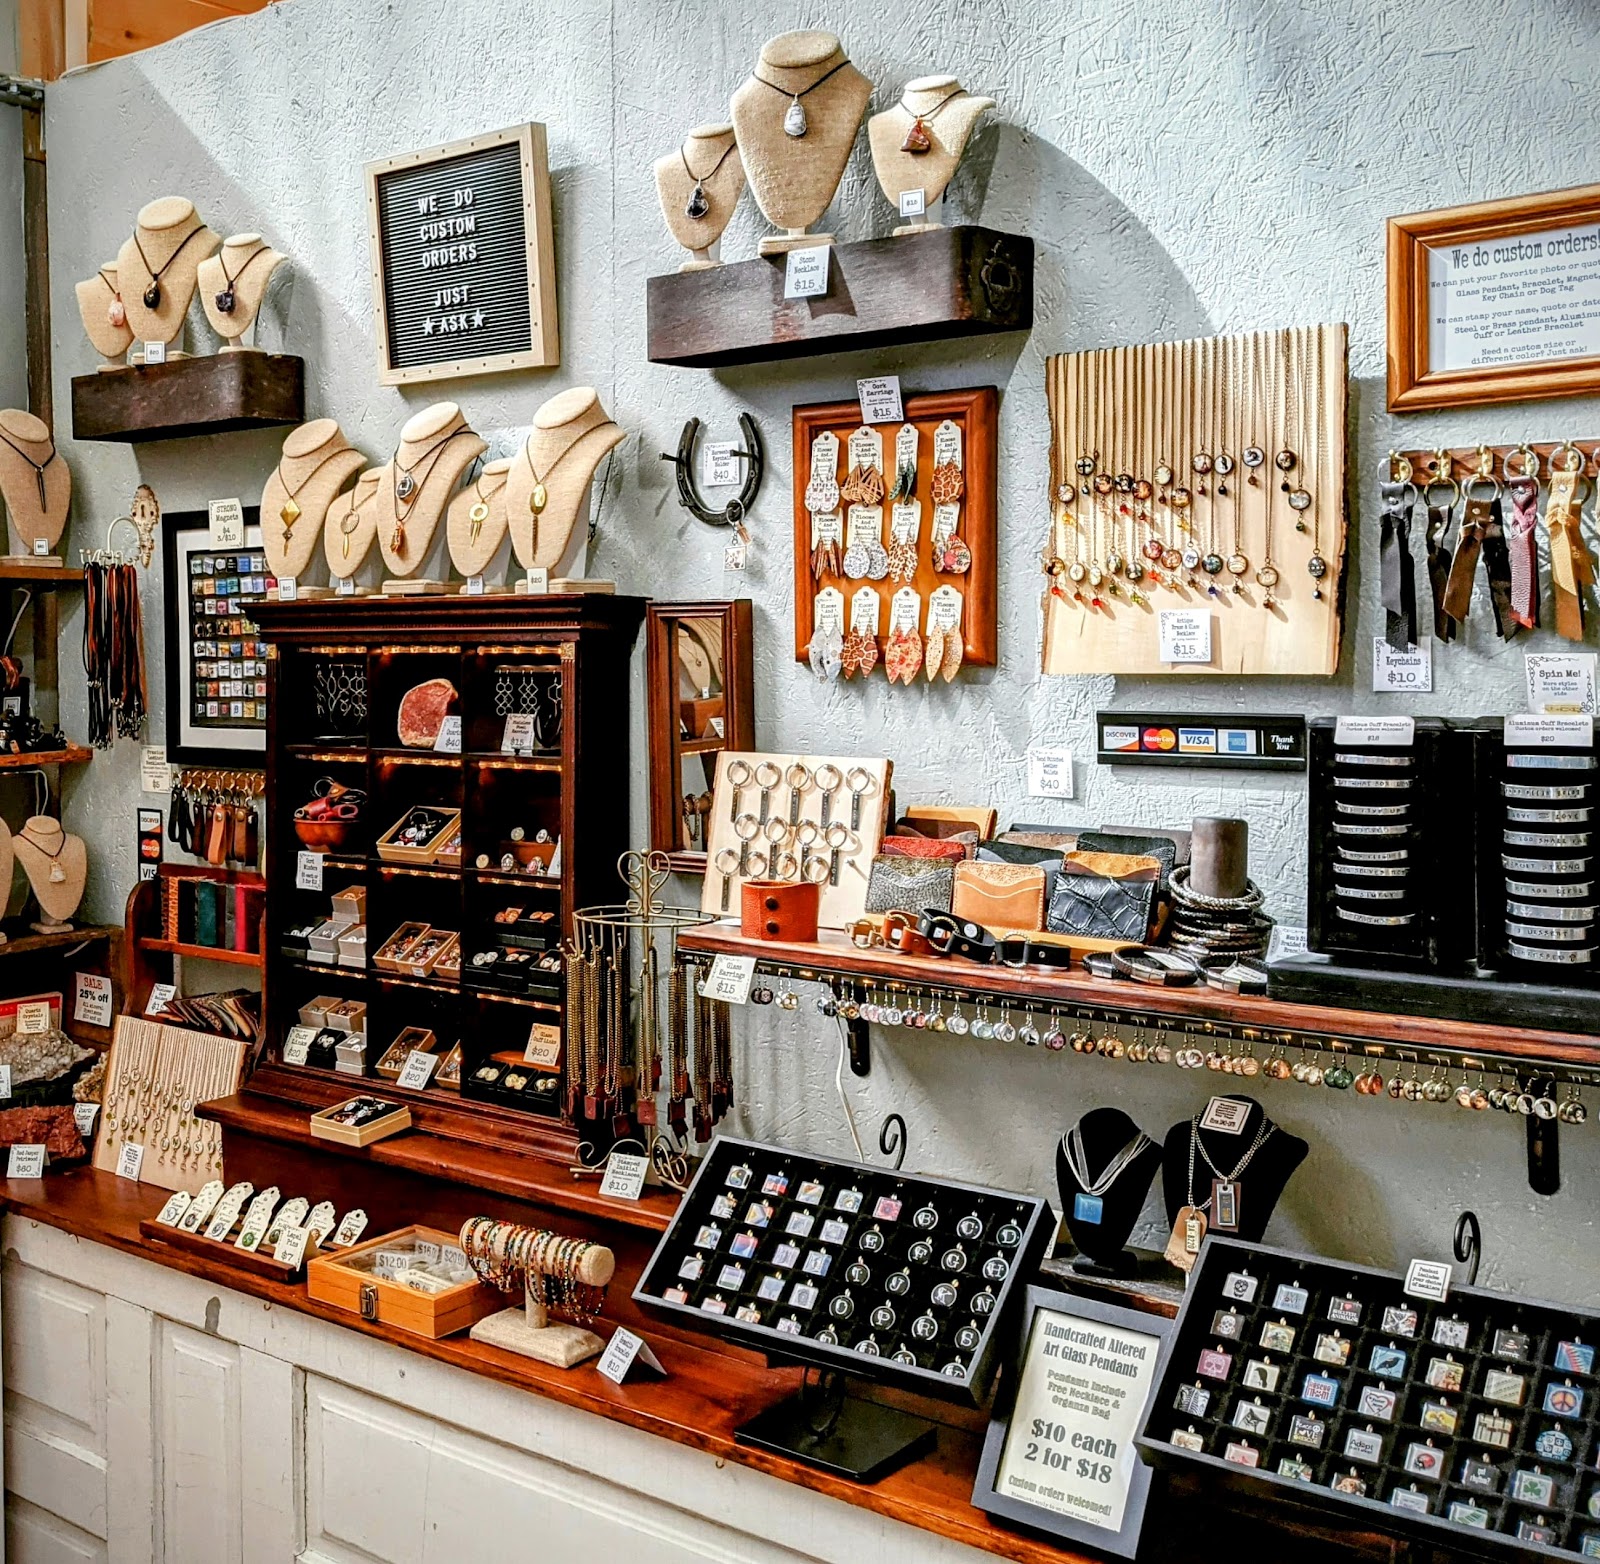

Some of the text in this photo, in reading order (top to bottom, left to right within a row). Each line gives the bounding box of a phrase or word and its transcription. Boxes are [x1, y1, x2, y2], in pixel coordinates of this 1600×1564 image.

[417, 188, 473, 215] WE DO
[420, 214, 476, 242] CUSTOM
[421, 242, 478, 269] ORDERS
[799, 255, 815, 264] Stone
[1451, 249, 1469, 269] We
[1473, 246, 1489, 267] do
[1494, 240, 1543, 264] custom
[794, 265, 820, 274] Necklace
[1460, 277, 1475, 286] put
[1477, 274, 1497, 284] your
[1500, 268, 1538, 279] favorite
[1541, 265, 1566, 275] photo
[794, 279, 815, 291] $15
[1482, 284, 1519, 294] Pendant,
[1522, 278, 1564, 289] Bracelet,
[434, 285, 470, 307] JUST
[1482, 294, 1497, 302] Key
[1499, 291, 1525, 299] Chain
[1558, 284, 1575, 292] Tag
[1465, 313, 1490, 321] stamp
[1491, 310, 1513, 319] your
[1541, 303, 1567, 312] quote
[1454, 325, 1478, 334] Steel
[1492, 321, 1517, 329] Brass
[1519, 316, 1558, 328] pendant,
[1473, 331, 1494, 339] Cuff
[1507, 326, 1542, 335] Leather
[1544, 320, 1584, 331] Bracelet
[1481, 347, 1502, 355] Need
[1511, 344, 1541, 352] custom
[1543, 341, 1563, 349] size
[1471, 354, 1513, 365] different
[1515, 349, 1545, 360] color?
[1569, 345, 1588, 354] ask!
[872, 407, 892, 418] $15
[713, 469, 728, 481] $40
[216, 504, 237, 513] STRONG
[215, 514, 239, 523] Magnets
[1173, 642, 1196, 657] $15
[1386, 656, 1421, 667] Keychains
[1387, 670, 1416, 684] $10
[1539, 670, 1581, 679] Spin Me!
[1106, 731, 1137, 739] DISCOVER
[1185, 736, 1210, 745] VISA
[1270, 735, 1294, 744] Thank
[445, 737, 460, 747] $40
[1276, 742, 1290, 750] You
[1040, 776, 1059, 791] $40
[142, 868, 156, 879] VIS
[726, 962, 742, 970] Glass
[719, 969, 746, 979] Earrings
[84, 977, 103, 990] SALE
[716, 980, 736, 994] $15
[79, 989, 109, 1003] 25% off
[287, 1047, 301, 1058] $20
[531, 1045, 549, 1057] $20
[404, 1070, 420, 1082] $20
[616, 1164, 638, 1172] Initial
[617, 1159, 640, 1167] Stamped
[612, 1169, 640, 1178] Necklaces
[608, 1180, 628, 1191] $10
[287, 1230, 302, 1241] Lapel
[286, 1238, 299, 1248] Pins
[281, 1250, 294, 1261] $7
[379, 1254, 407, 1269] $12.00
[1043, 1322, 1147, 1360] Handcrafted Altered
[1042, 1340, 1138, 1378] Art Glass Pendants
[1047, 1369, 1126, 1398] Pendants Include
[1047, 1381, 1120, 1409] Free Necklace &
[1051, 1394, 1111, 1420] Organza Bag
[1031, 1418, 1118, 1459] $10 each
[1024, 1442, 1112, 1484] 2 for $18
[1008, 1474, 1112, 1516] Custom orders welcomed!
